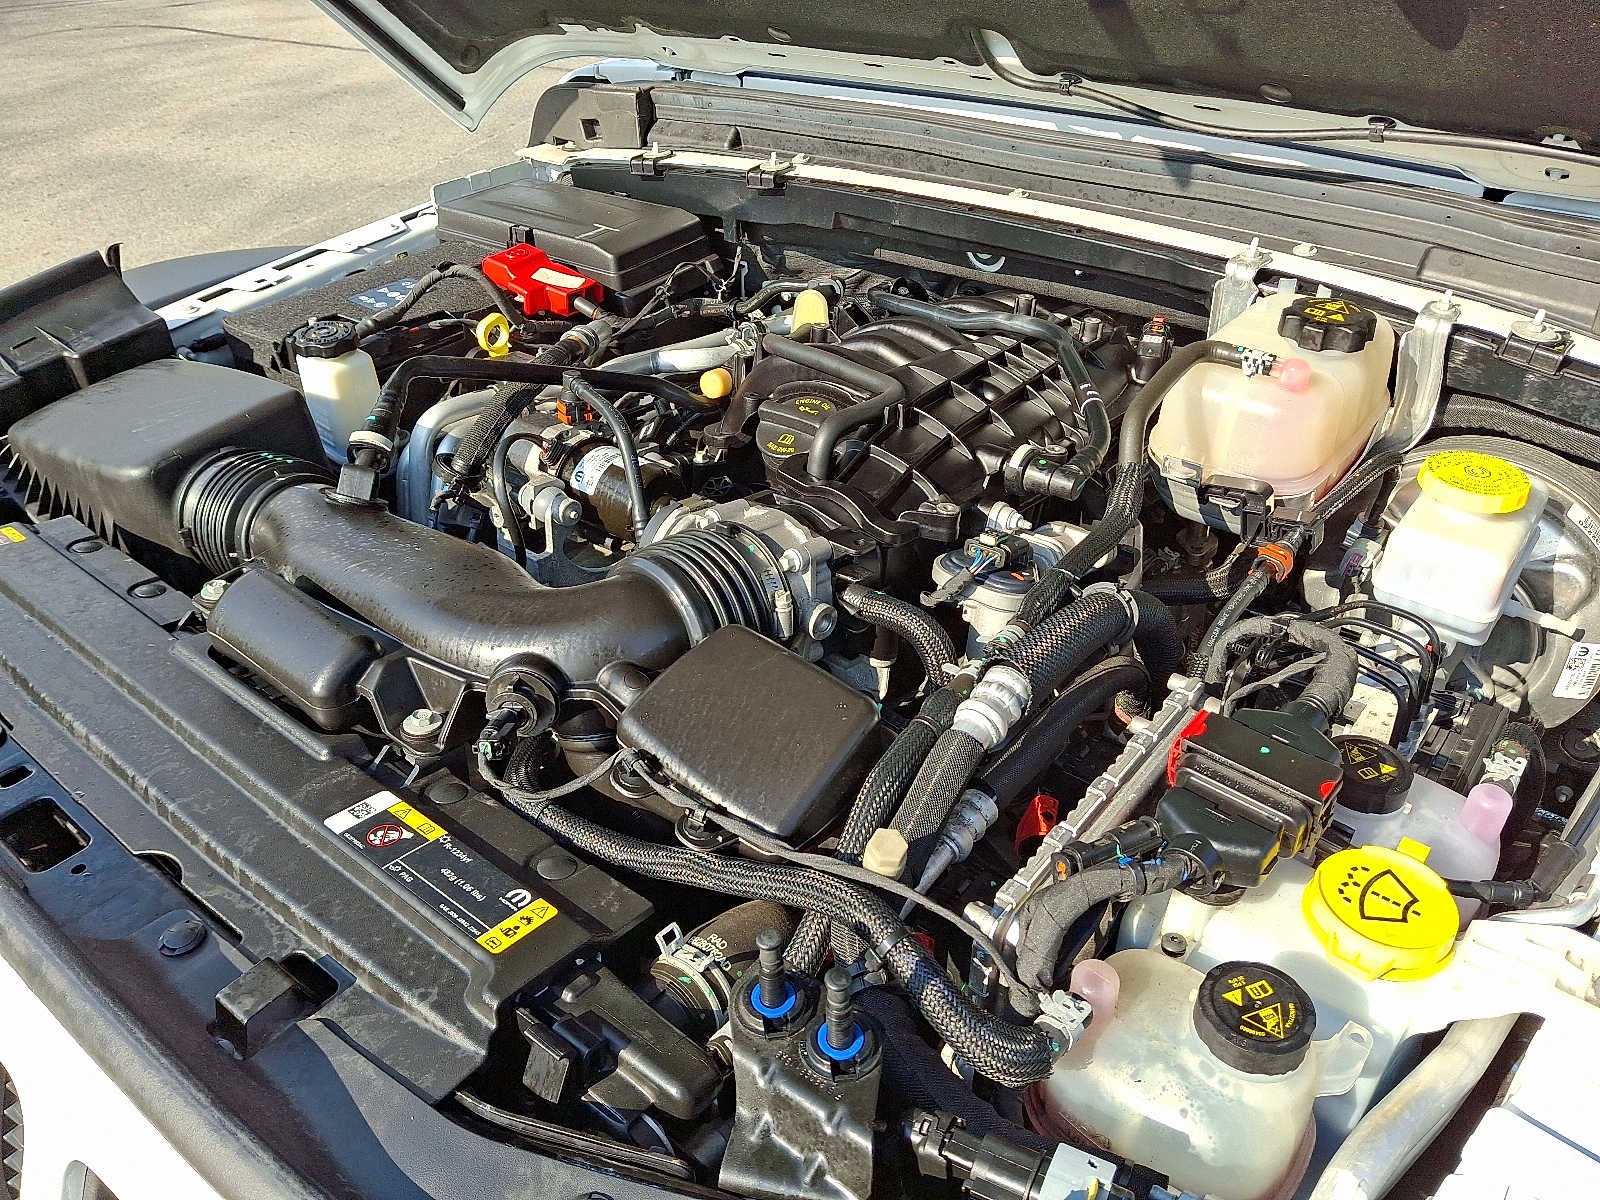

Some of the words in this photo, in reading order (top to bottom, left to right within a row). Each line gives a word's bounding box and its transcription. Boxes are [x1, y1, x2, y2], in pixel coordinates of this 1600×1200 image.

[796, 398, 821, 406] ENGINE
[398, 870, 414, 884] PAG
[469, 886, 487, 903] lbs)
[707, 933, 728, 950] RAD
